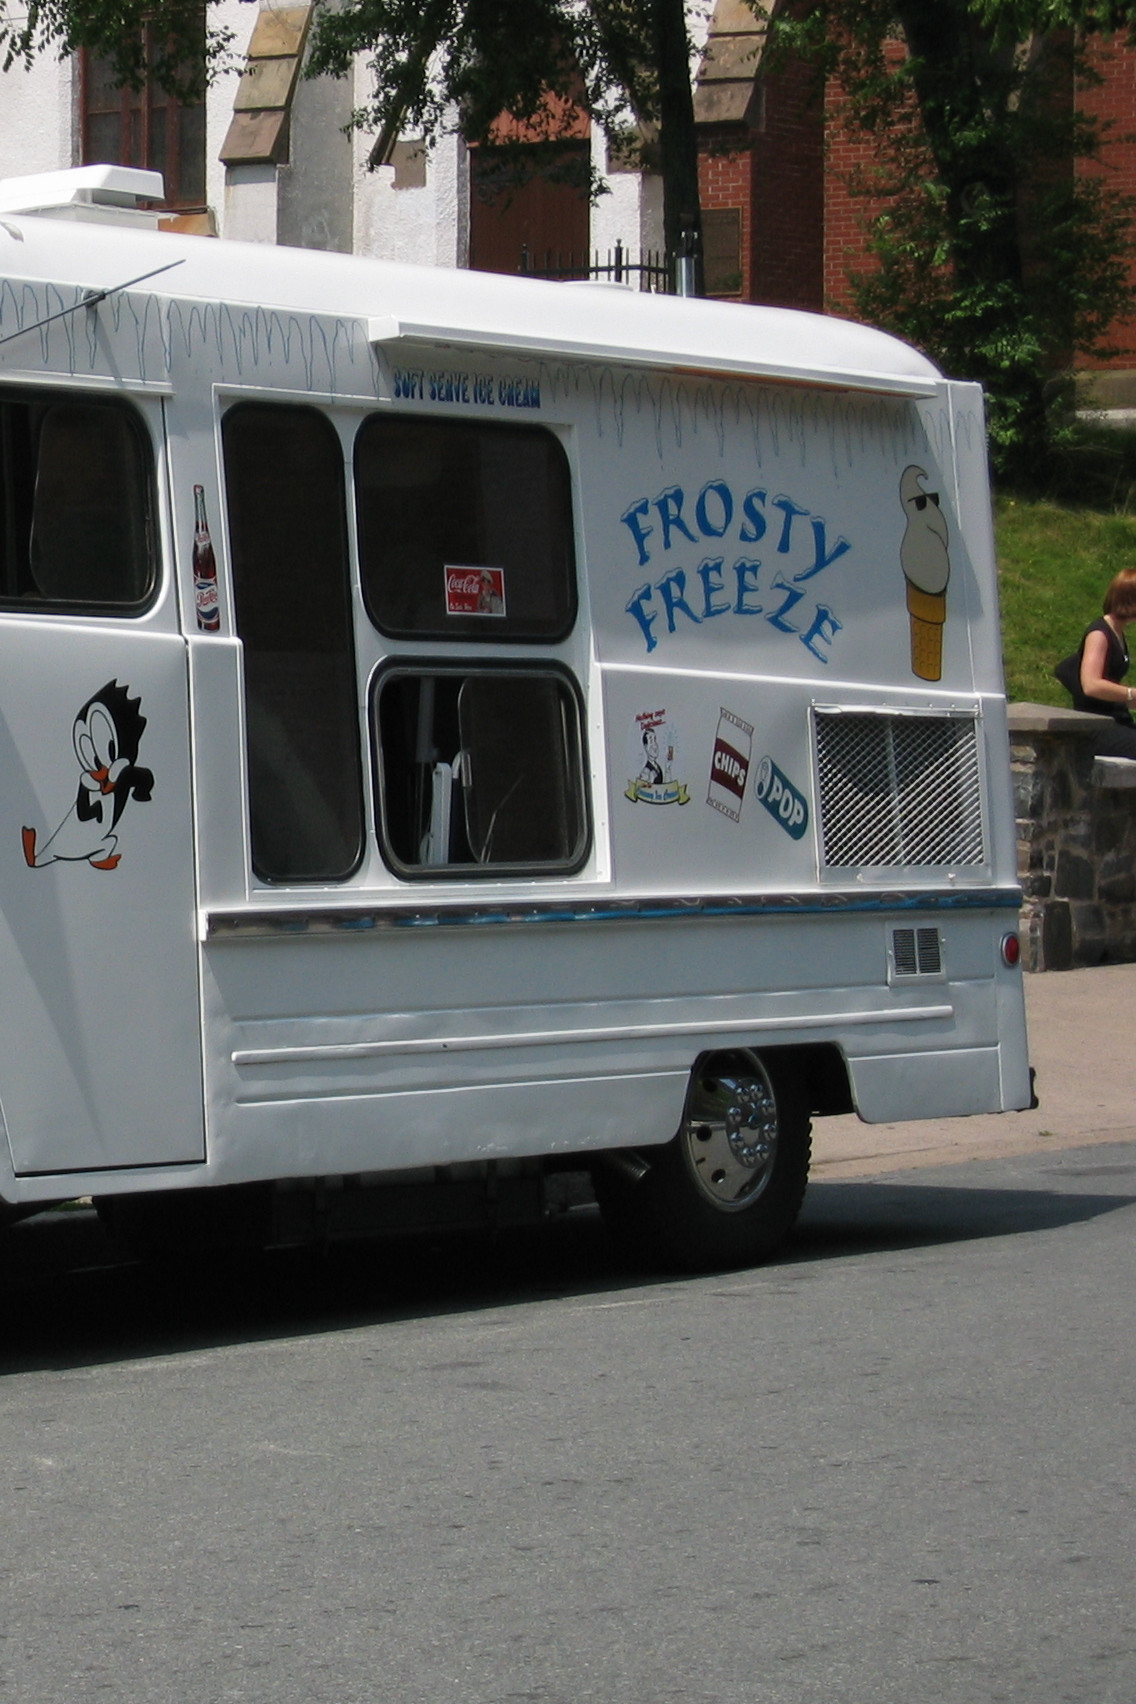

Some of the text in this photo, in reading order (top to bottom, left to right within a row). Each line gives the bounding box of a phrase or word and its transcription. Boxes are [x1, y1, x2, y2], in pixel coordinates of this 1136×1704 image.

[394, 368, 541, 409] SOFT SERVE ICE CREAM
[620, 479, 851, 583] FROSTY
[625, 556, 843, 664] FREEZE
[714, 750, 746, 788] CHIPS
[767, 775, 805, 827] POP
